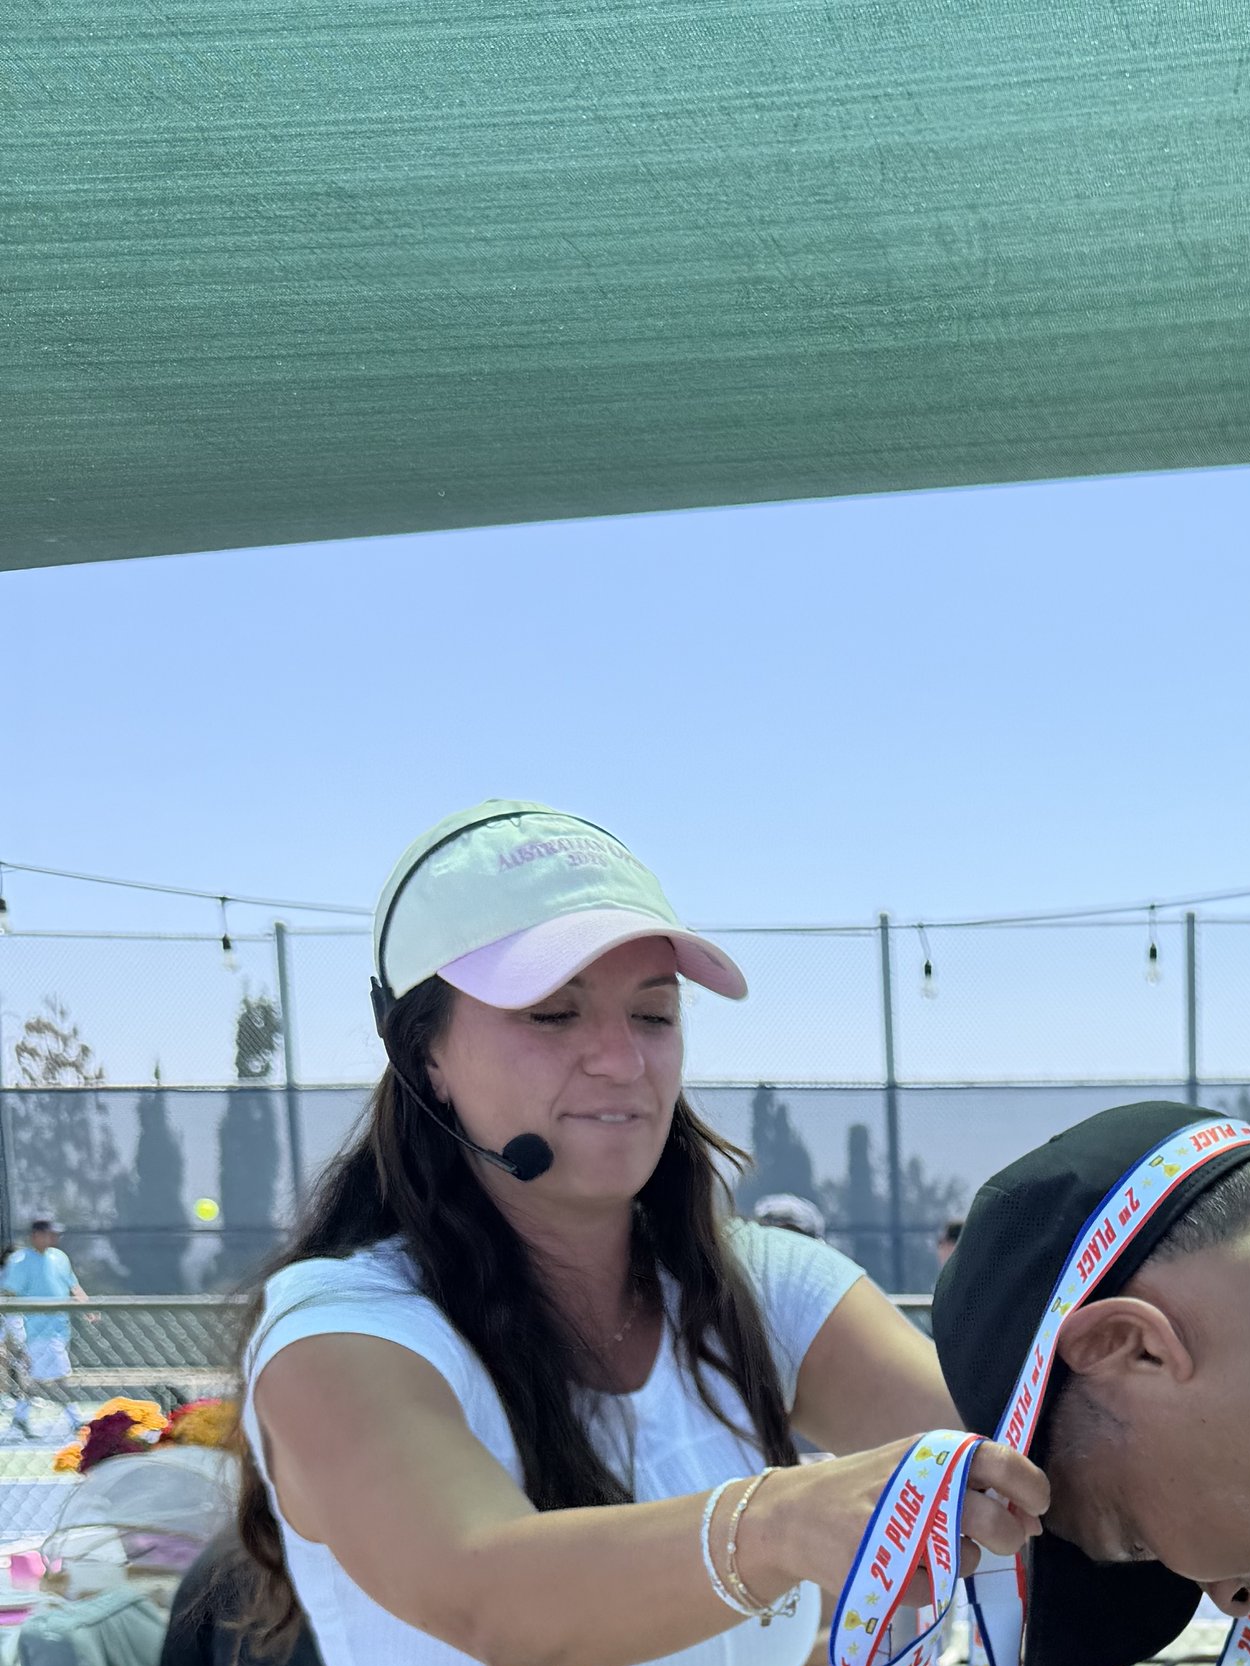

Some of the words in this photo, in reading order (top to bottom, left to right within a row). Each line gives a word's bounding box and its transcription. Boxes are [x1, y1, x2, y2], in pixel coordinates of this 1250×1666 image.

[1189, 1123, 1237, 1152] PLACE
[1076, 1217, 1117, 1284] PLACE
[884, 1479, 925, 1553] PLACE
